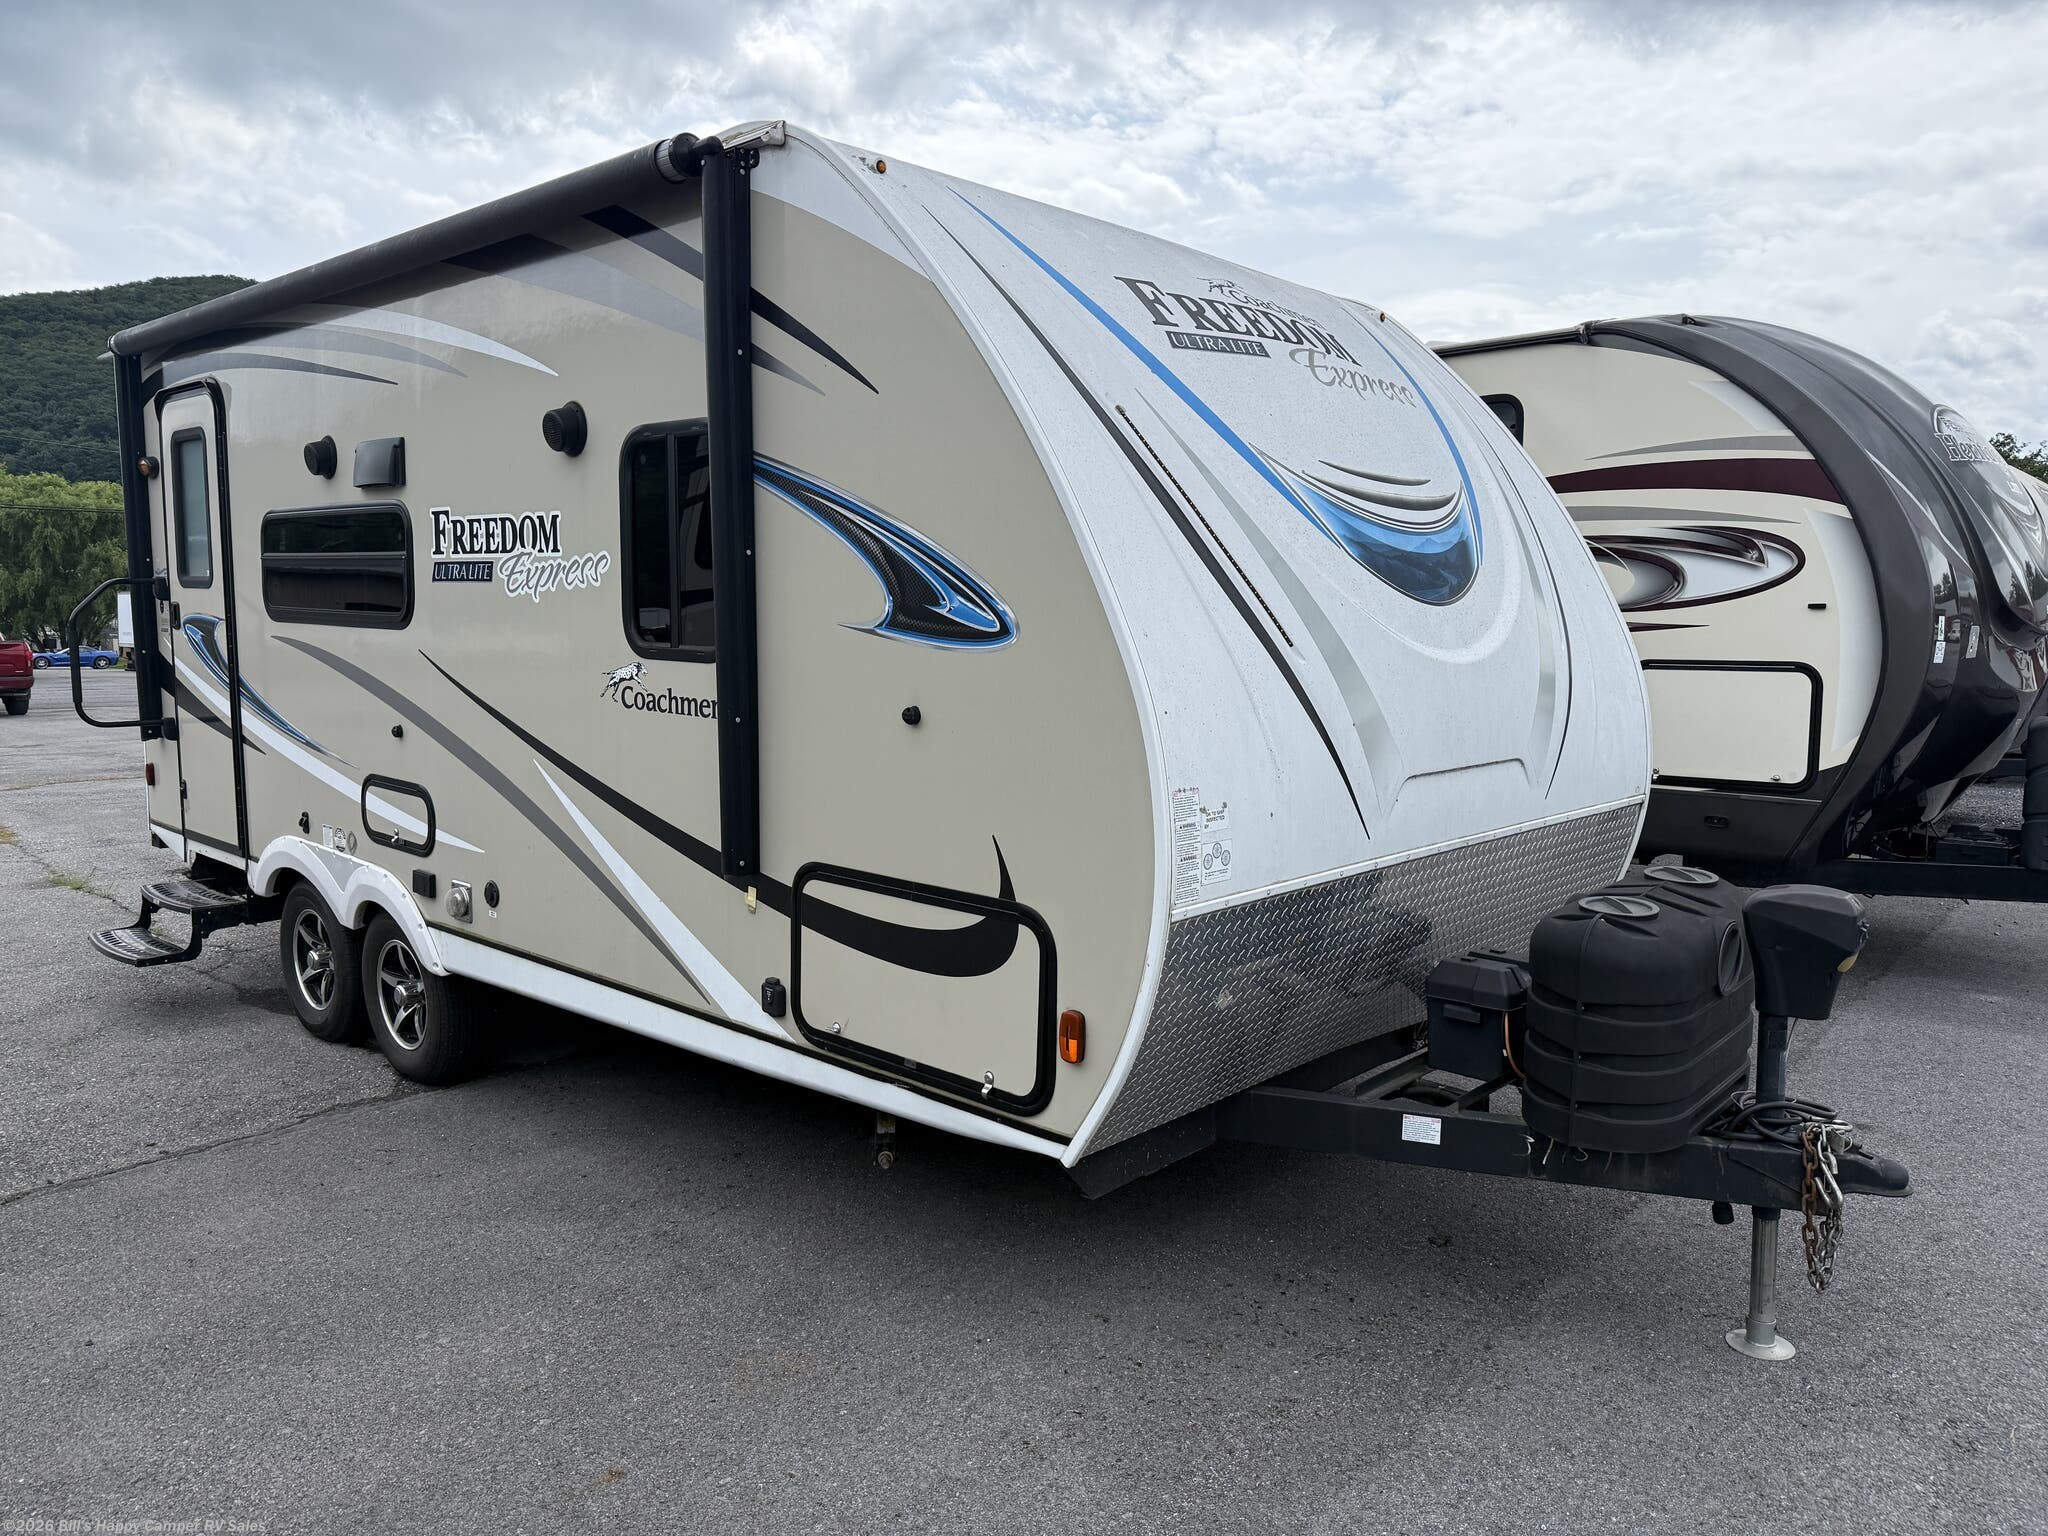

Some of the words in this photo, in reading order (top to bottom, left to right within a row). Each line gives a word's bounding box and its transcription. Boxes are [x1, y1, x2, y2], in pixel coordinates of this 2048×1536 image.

[1113, 276, 1362, 367] FREEDOM
[1289, 348, 1417, 408] Express
[430, 508, 562, 557] FREEDOM
[499, 551, 609, 602] Express
